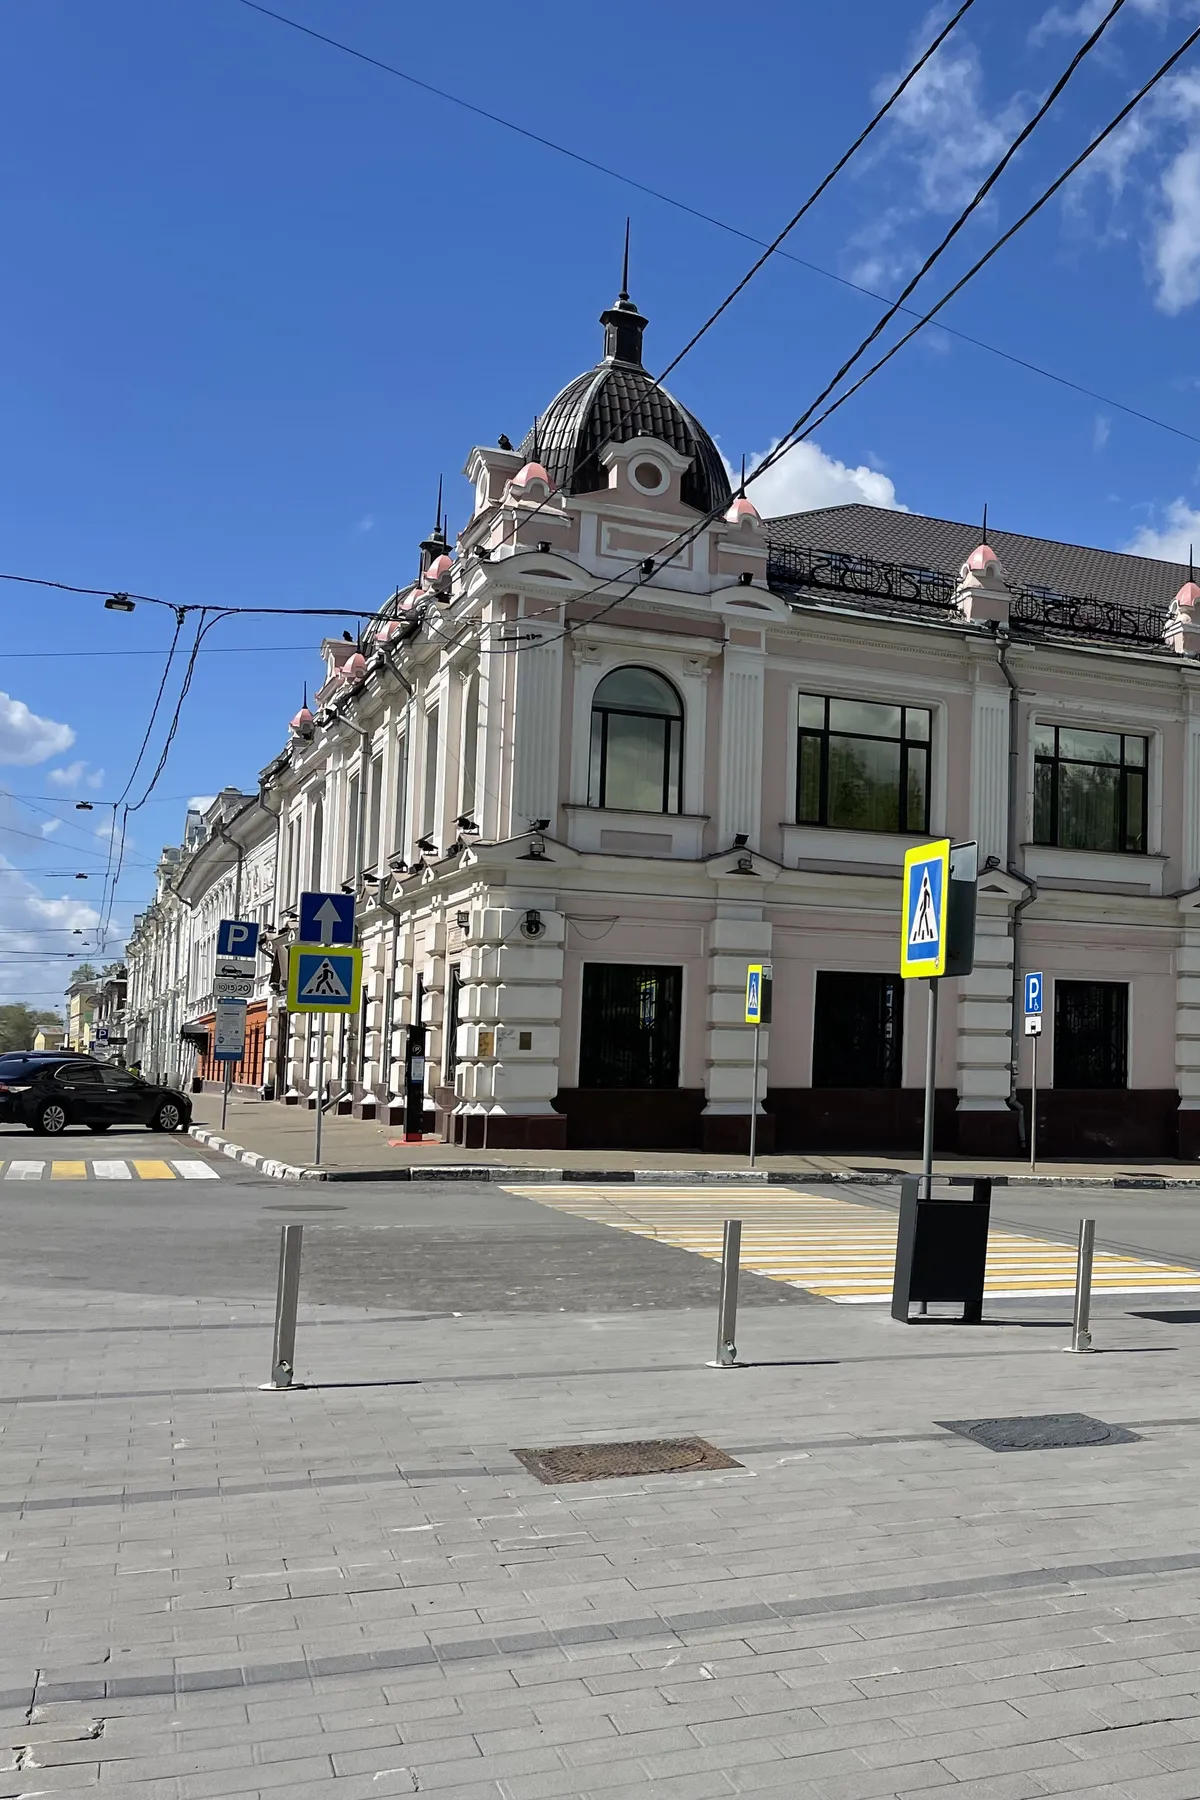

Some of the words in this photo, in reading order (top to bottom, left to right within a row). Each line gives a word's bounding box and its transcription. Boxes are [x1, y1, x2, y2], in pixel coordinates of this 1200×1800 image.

[227, 924, 249, 953] P
[237, 984, 249, 992] 20
[1029, 977, 1040, 1009] P
[98, 1029, 107, 1040] P
